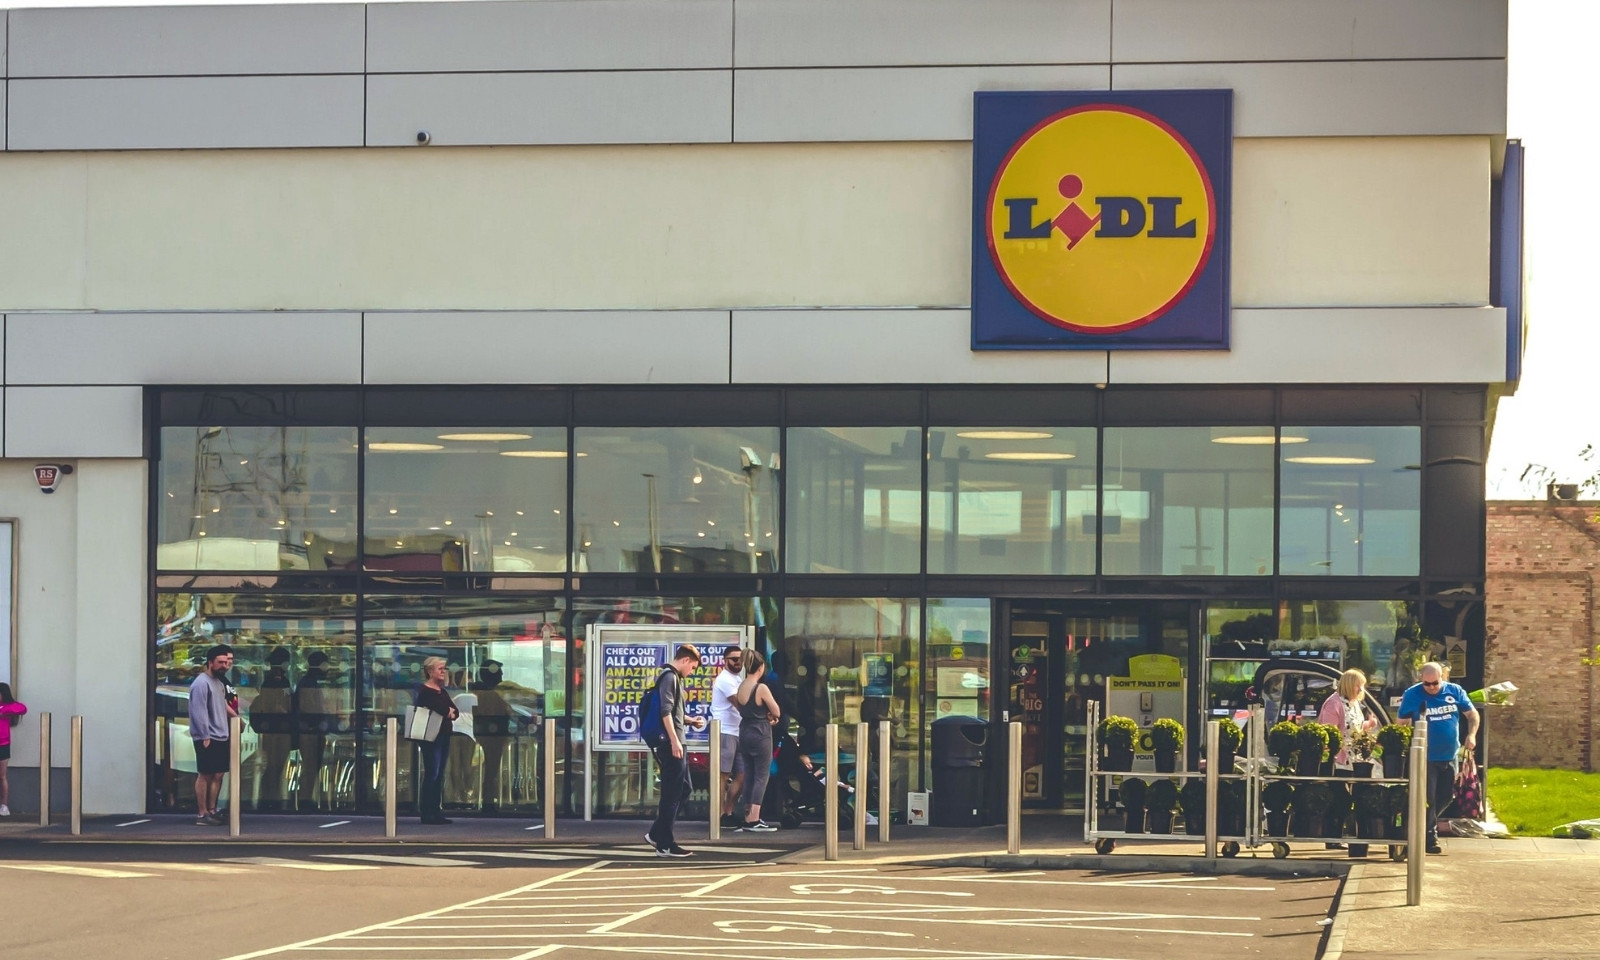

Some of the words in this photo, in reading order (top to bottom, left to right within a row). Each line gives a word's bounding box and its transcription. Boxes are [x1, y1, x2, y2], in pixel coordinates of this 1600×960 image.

[40, 469, 53, 478] RS
[605, 647, 635, 655] CHECK
[636, 647, 656, 655] OUT
[605, 656, 627, 666] ALL
[628, 656, 655, 666] OUR
[700, 655, 725, 665] OUR
[605, 678, 656, 690] SPECIA
[1113, 680, 1136, 688] DON'T
[1138, 680, 1156, 688] PASS
[605, 690, 643, 704] OFFE
[1025, 699, 1043, 710] BIG
[1425, 704, 1458, 715] ANGERS
[604, 716, 640, 733] NO
